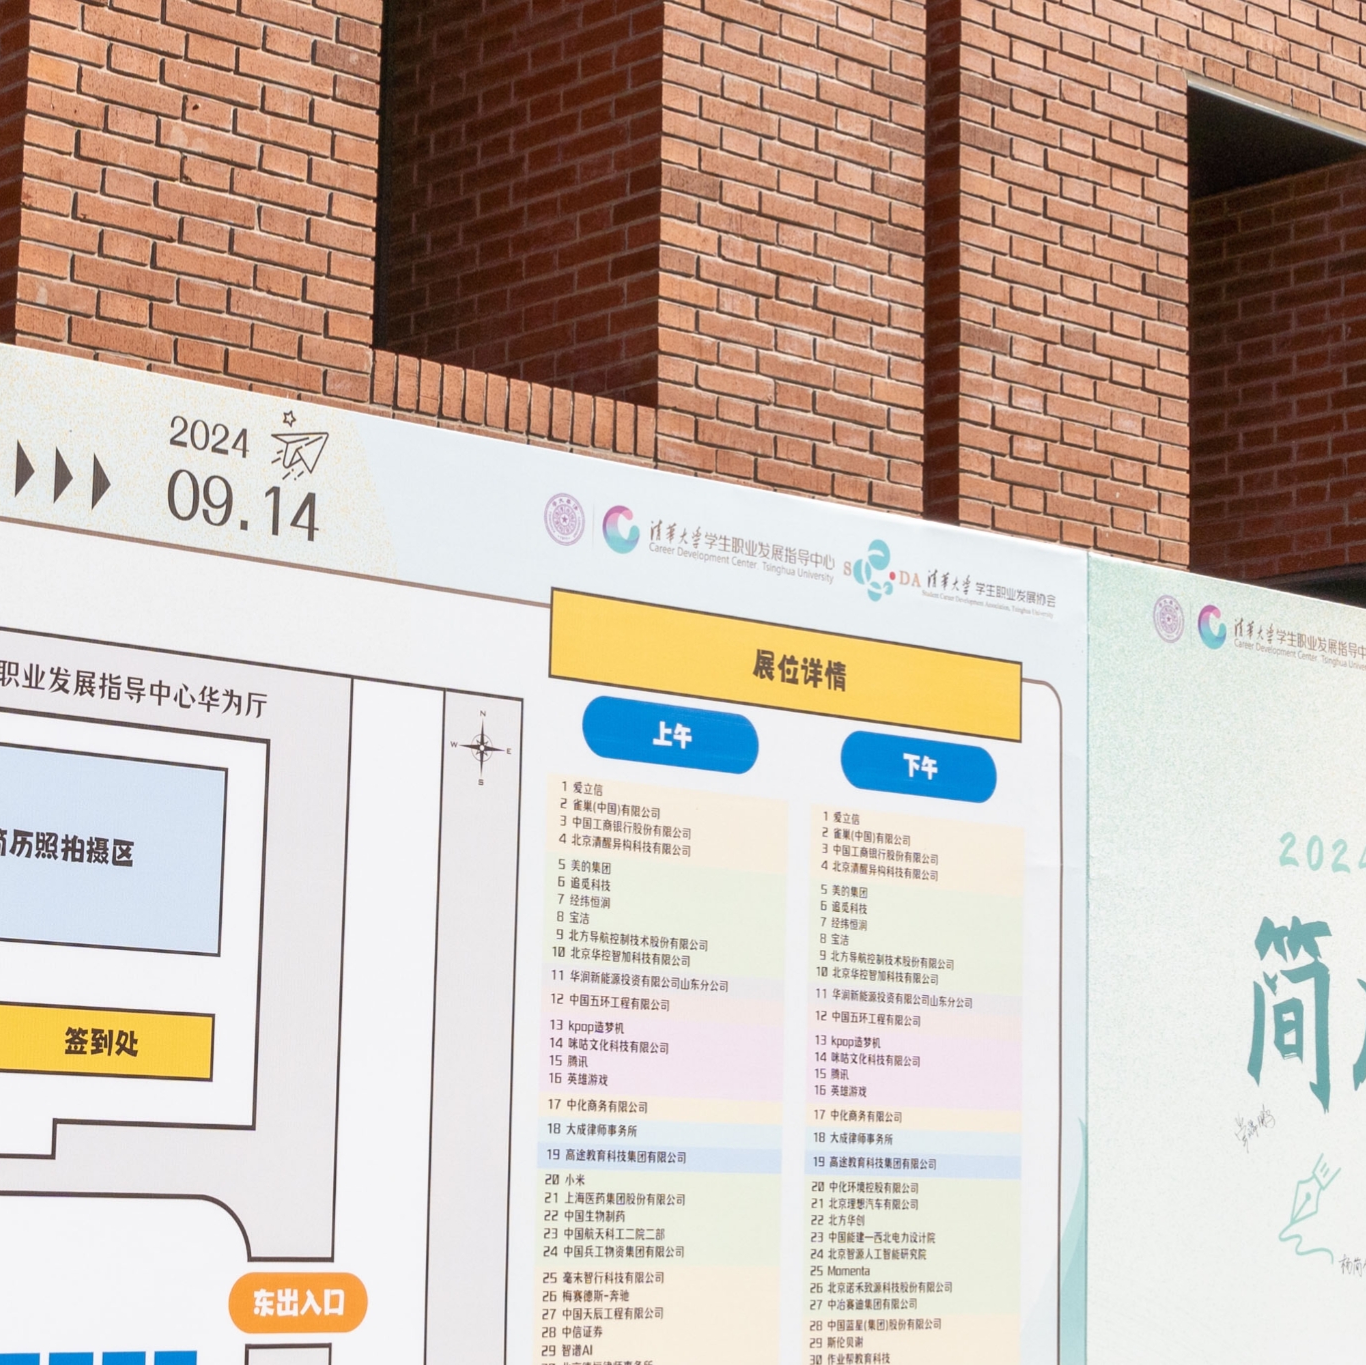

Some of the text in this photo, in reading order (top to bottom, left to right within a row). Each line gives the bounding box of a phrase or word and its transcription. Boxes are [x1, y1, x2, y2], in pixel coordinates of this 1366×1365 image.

[169, 415, 250, 458] 2024
[167, 468, 319, 541] 09.14
[649, 542, 675, 554] Career
[678, 547, 729, 564] Development
[763, 562, 795, 576] Tsinghua
[798, 569, 834, 585] University
[752, 648, 847, 692] 展位详情
[652, 720, 692, 749] 上午
[903, 752, 938, 780] 下午
[562, 781, 603, 797] 1 爱立信
[560, 816, 691, 840] 3 中国工商银行股份有限公司
[559, 859, 611, 874] 5 美的集团
[821, 901, 867, 915] 6 追觅科技
[551, 994, 670, 1011] 12 中国五环工程有限公司
[550, 1020, 624, 1034] 13 kpop造梦机
[64, 1026, 139, 1058] 签到处
[548, 1099, 647, 1113] 17 中化商务有限公司
[814, 1132, 893, 1145] 18 大成律师事务所
[547, 1149, 686, 1164] 19 高途教育科技集团有限公司
[811, 1214, 865, 1226] 22 北方华创
[544, 1228, 665, 1240] 23 中国航天科工二院二部
[810, 1266, 870, 1276] 25 Momenta
[252, 1287, 345, 1318] 东出入口
[542, 1326, 603, 1338] 28 中信证券
